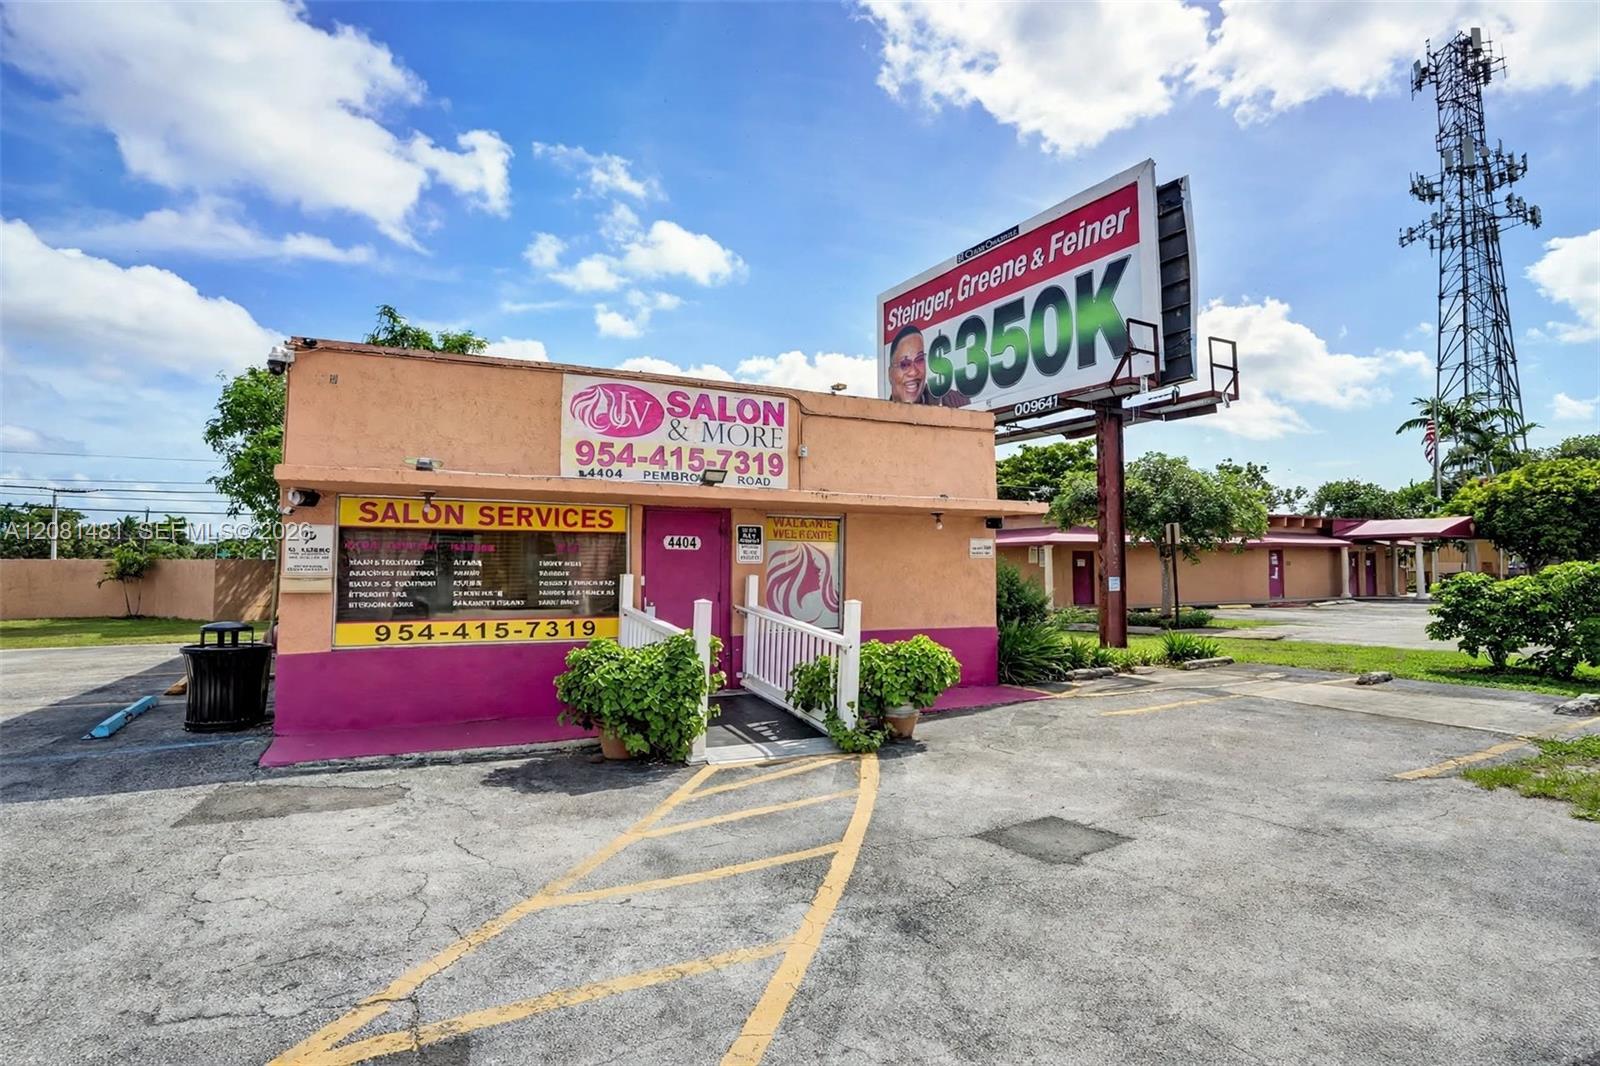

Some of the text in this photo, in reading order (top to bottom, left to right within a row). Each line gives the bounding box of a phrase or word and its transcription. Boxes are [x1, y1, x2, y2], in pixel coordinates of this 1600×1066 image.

[887, 286, 954, 331] Steinger,
[957, 254, 1027, 302] Greene
[1030, 247, 1045, 270] &
[1049, 206, 1131, 263] Feiner
[927, 253, 1133, 398] $350K
[666, 390, 785, 427] SALON
[1014, 394, 1058, 416] 009641
[668, 418, 784, 449] & MORE
[575, 440, 785, 477] 954-415-7319
[737, 475, 771, 487] ROAD
[358, 501, 614, 529] SALON SERVICES
[667, 536, 697, 549] 4404
[375, 620, 596, 642] 954-415-7319
